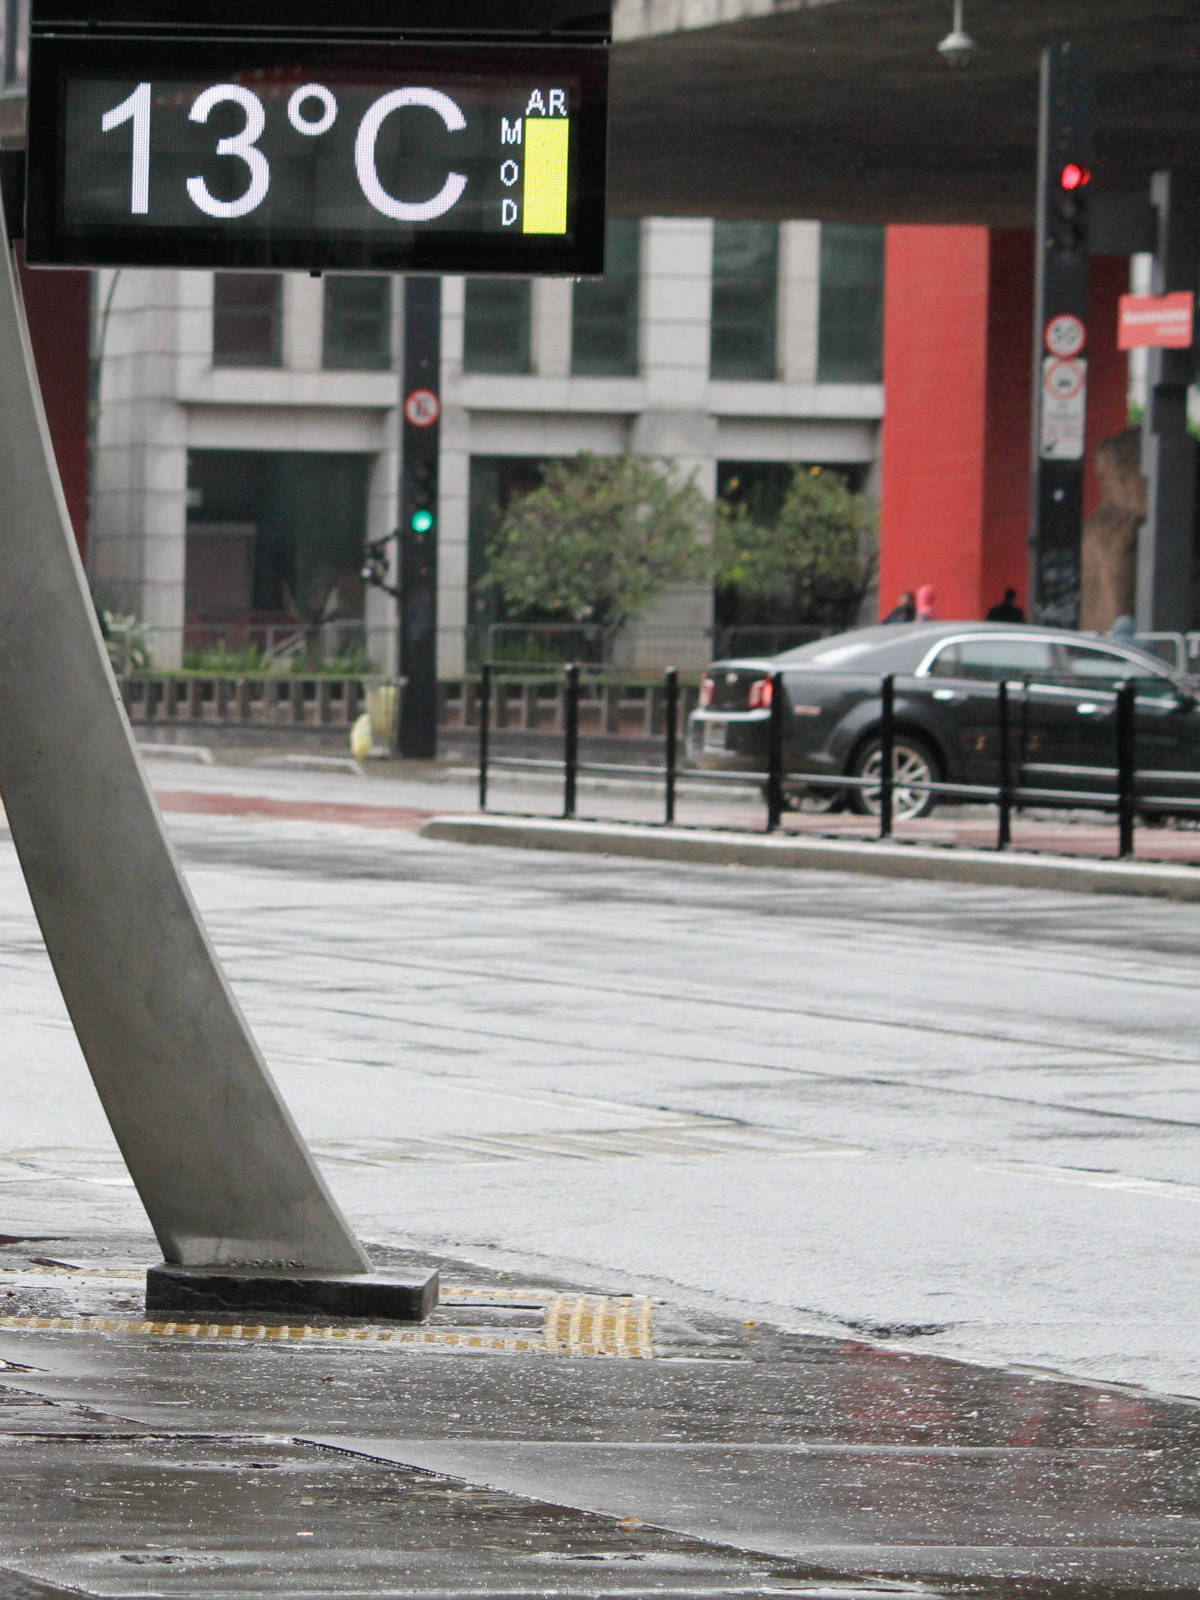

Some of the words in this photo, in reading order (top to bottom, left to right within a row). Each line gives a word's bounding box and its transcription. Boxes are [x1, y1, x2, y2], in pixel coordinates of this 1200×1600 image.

[102, 82, 468, 222] 13°C
[525, 88, 568, 117] AR
[500, 117, 522, 226] MOD
